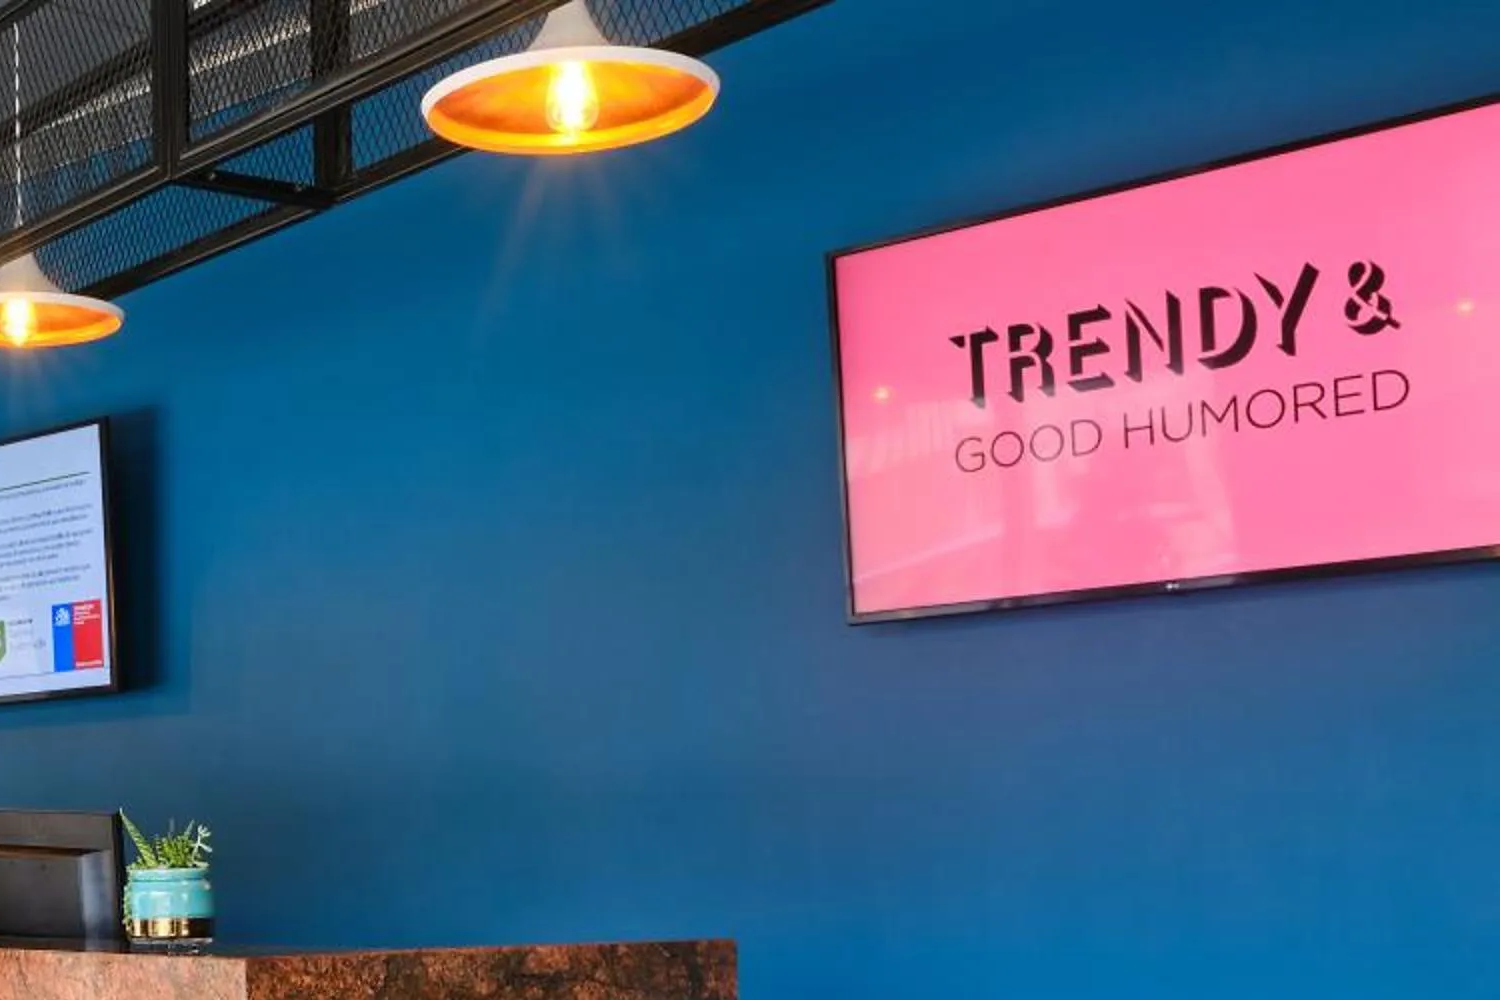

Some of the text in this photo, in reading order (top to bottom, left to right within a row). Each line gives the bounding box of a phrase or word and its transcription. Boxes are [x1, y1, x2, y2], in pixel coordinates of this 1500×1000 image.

[949, 260, 1401, 408] TRENDY &
[954, 368, 1411, 473] GOOD HUMORED
